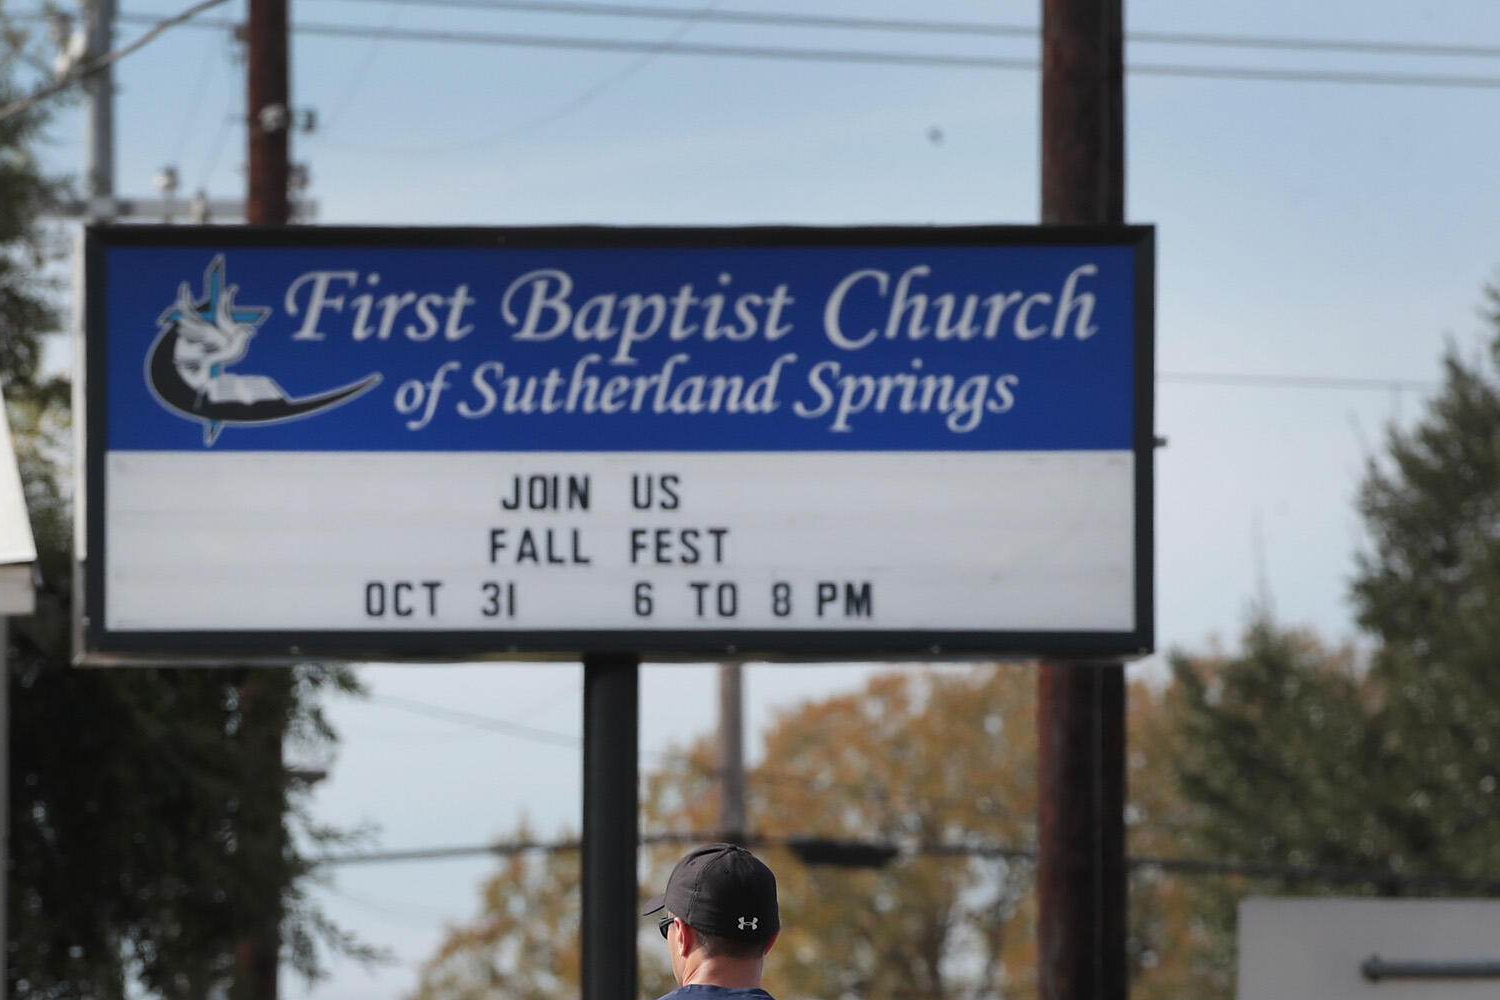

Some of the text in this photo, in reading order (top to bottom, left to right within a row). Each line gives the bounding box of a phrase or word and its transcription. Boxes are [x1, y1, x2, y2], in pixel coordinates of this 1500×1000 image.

[285, 265, 1098, 363] First Baptist Church
[394, 354, 1017, 430] of Sutherland Springs
[501, 474, 681, 512] JOIN US
[488, 528, 730, 565] FALL FEST
[364, 581, 873, 618] OCT 31 6 TO 8 PM
